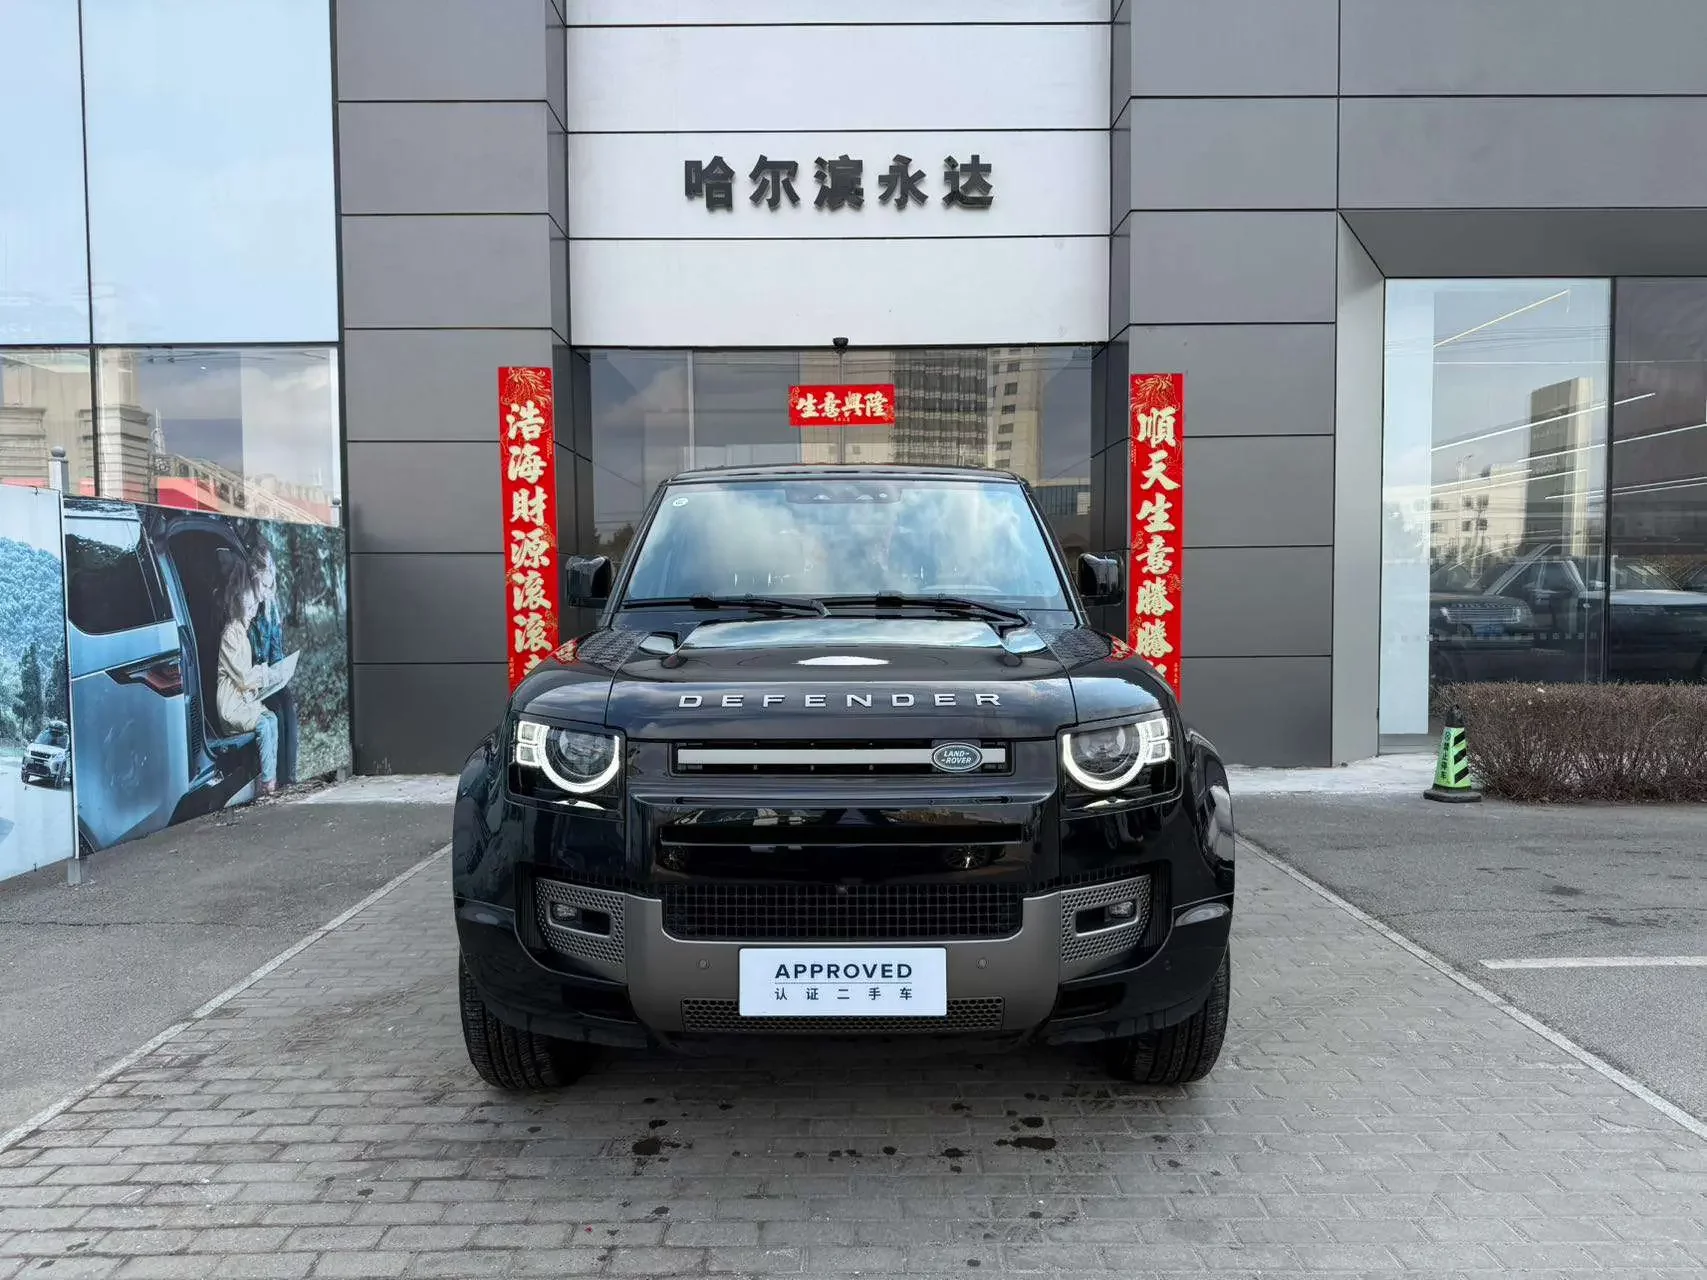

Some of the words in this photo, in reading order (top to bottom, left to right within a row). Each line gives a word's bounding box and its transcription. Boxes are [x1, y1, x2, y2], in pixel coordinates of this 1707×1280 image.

[684, 154, 995, 211] 哈尔滨永达
[1136, 406, 1181, 678] 順天生意騰騰
[678, 693, 1002, 708] DEFENDER
[775, 964, 912, 979] APPROVED
[774, 987, 913, 1001] 认证二手车
